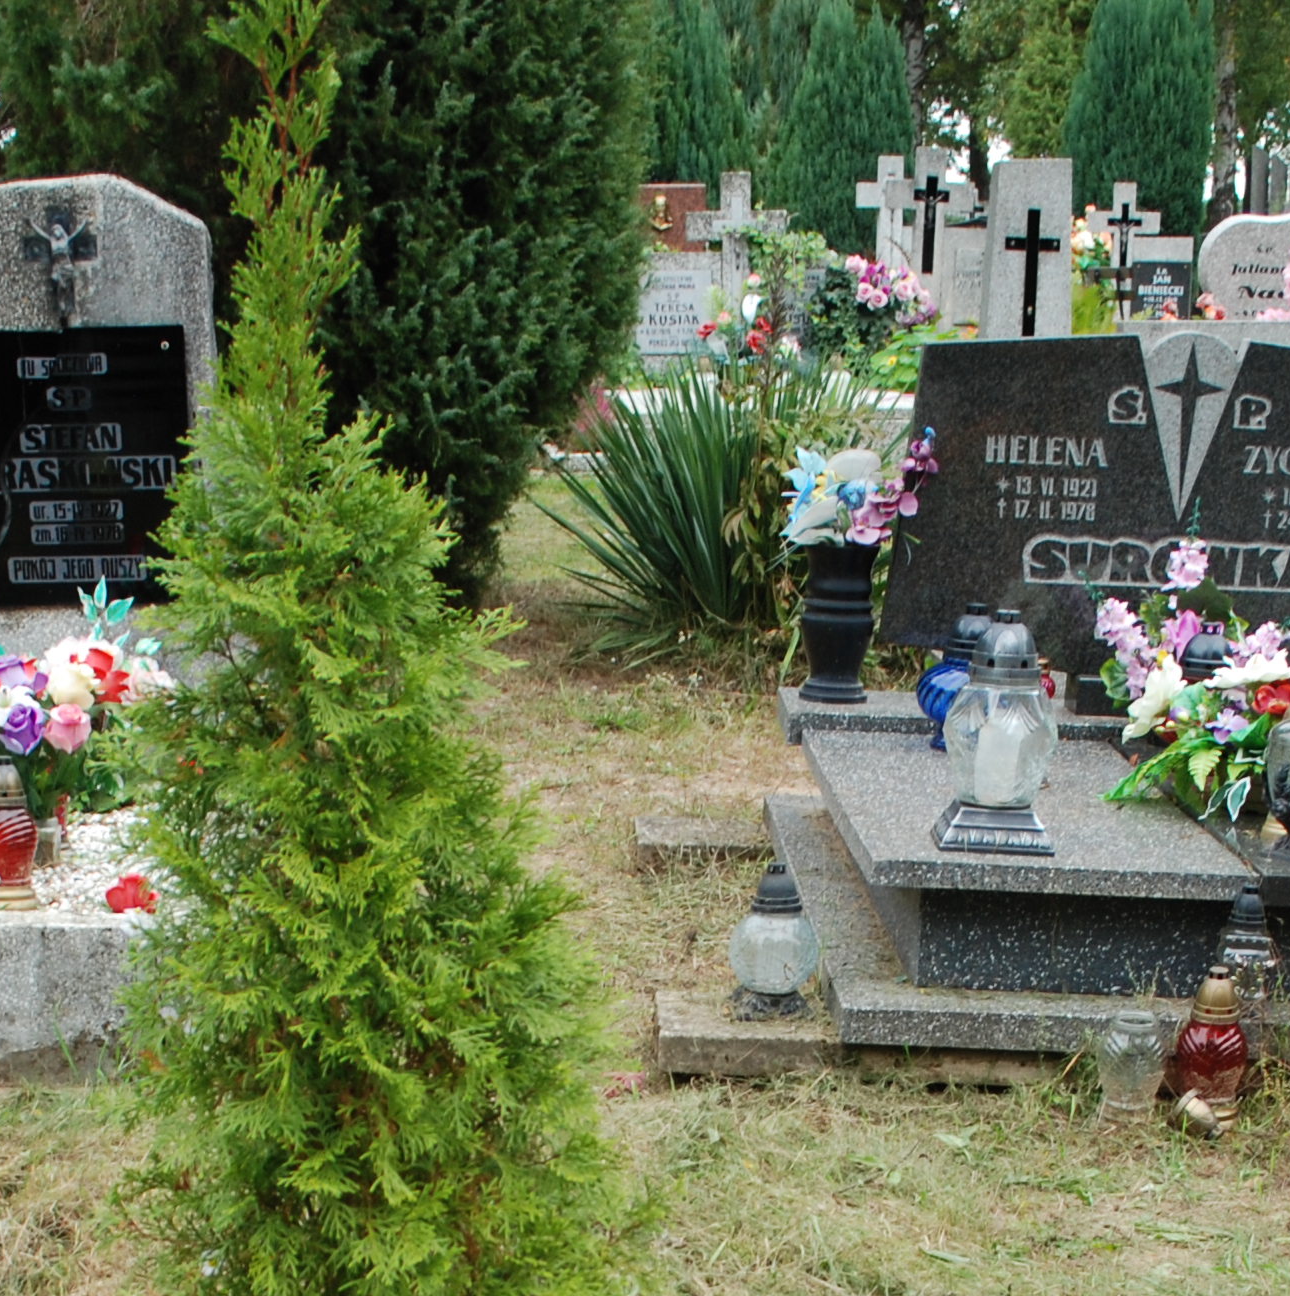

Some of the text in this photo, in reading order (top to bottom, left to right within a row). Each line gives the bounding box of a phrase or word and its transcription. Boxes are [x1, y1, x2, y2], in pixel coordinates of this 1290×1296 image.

[648, 314, 700, 326] KUSIAK
[23, 425, 117, 451] STEFAN
[985, 433, 1109, 468] HELENA
[1061, 501, 1096, 522] 1978
[13, 557, 142, 581] POKÓJ JEGO DUSZY
